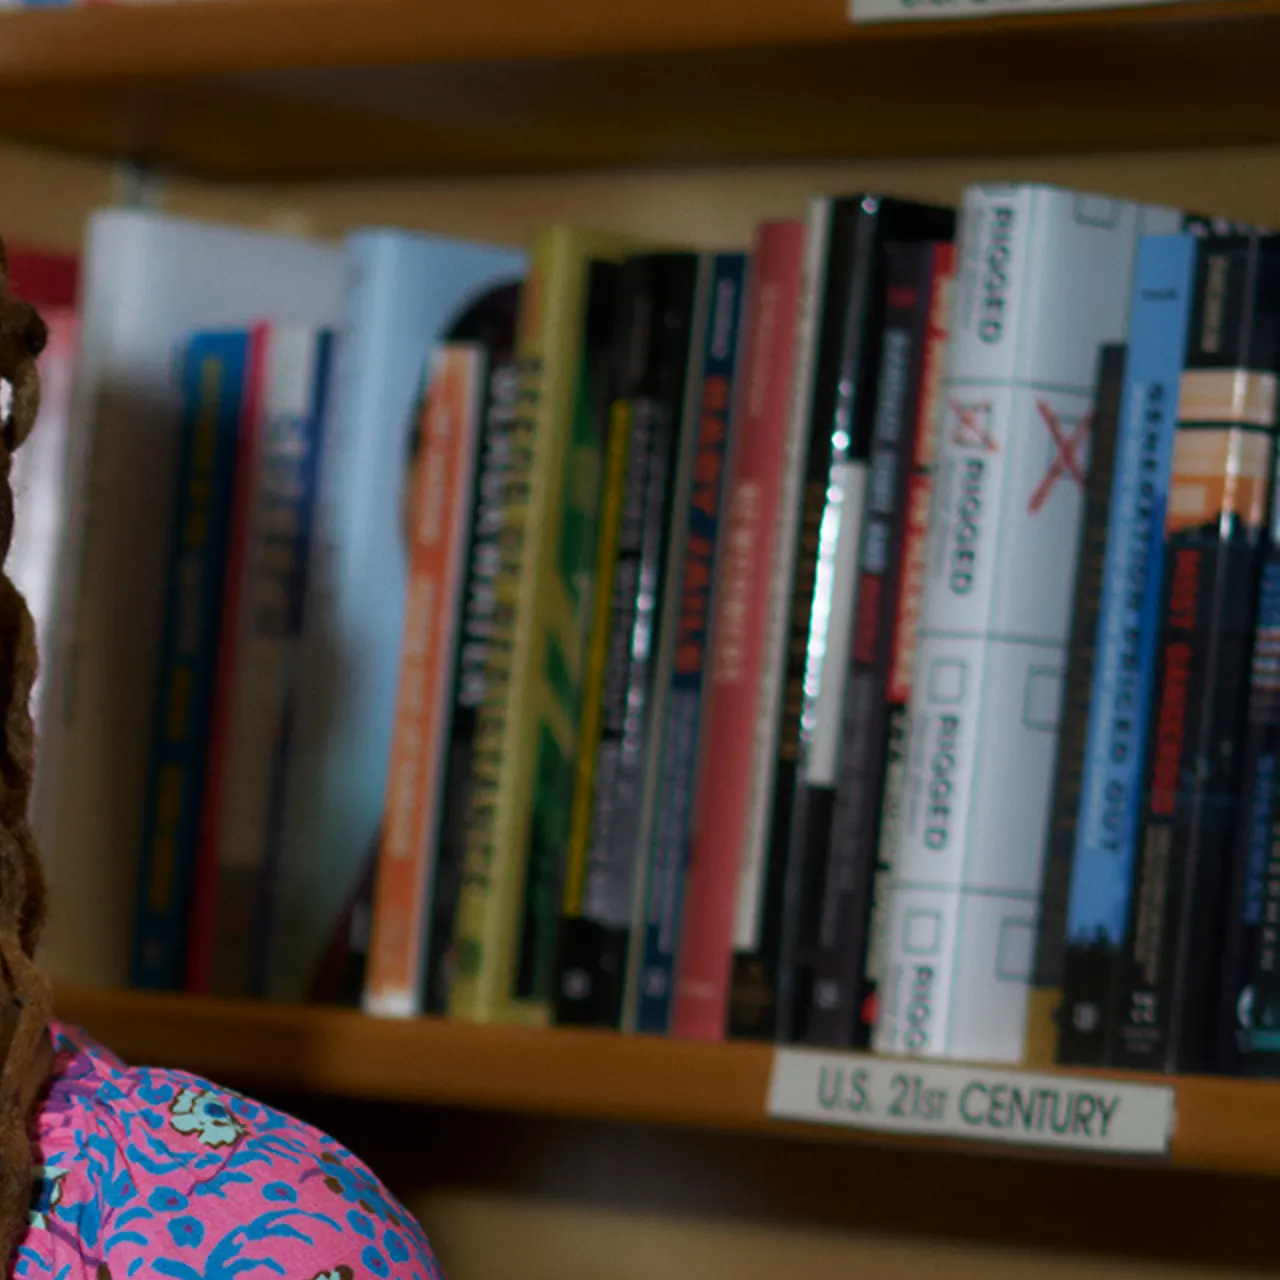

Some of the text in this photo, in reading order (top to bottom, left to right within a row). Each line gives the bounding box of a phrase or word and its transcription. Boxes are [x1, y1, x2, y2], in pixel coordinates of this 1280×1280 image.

[978, 205, 1015, 344] RIGGED
[951, 458, 986, 596] RIGGED
[925, 714, 959, 852] RIGGED
[1101, 779, 1130, 854] OUT
[818, 1067, 873, 1114] U.S.
[959, 1081, 1121, 1139] CENTURY
